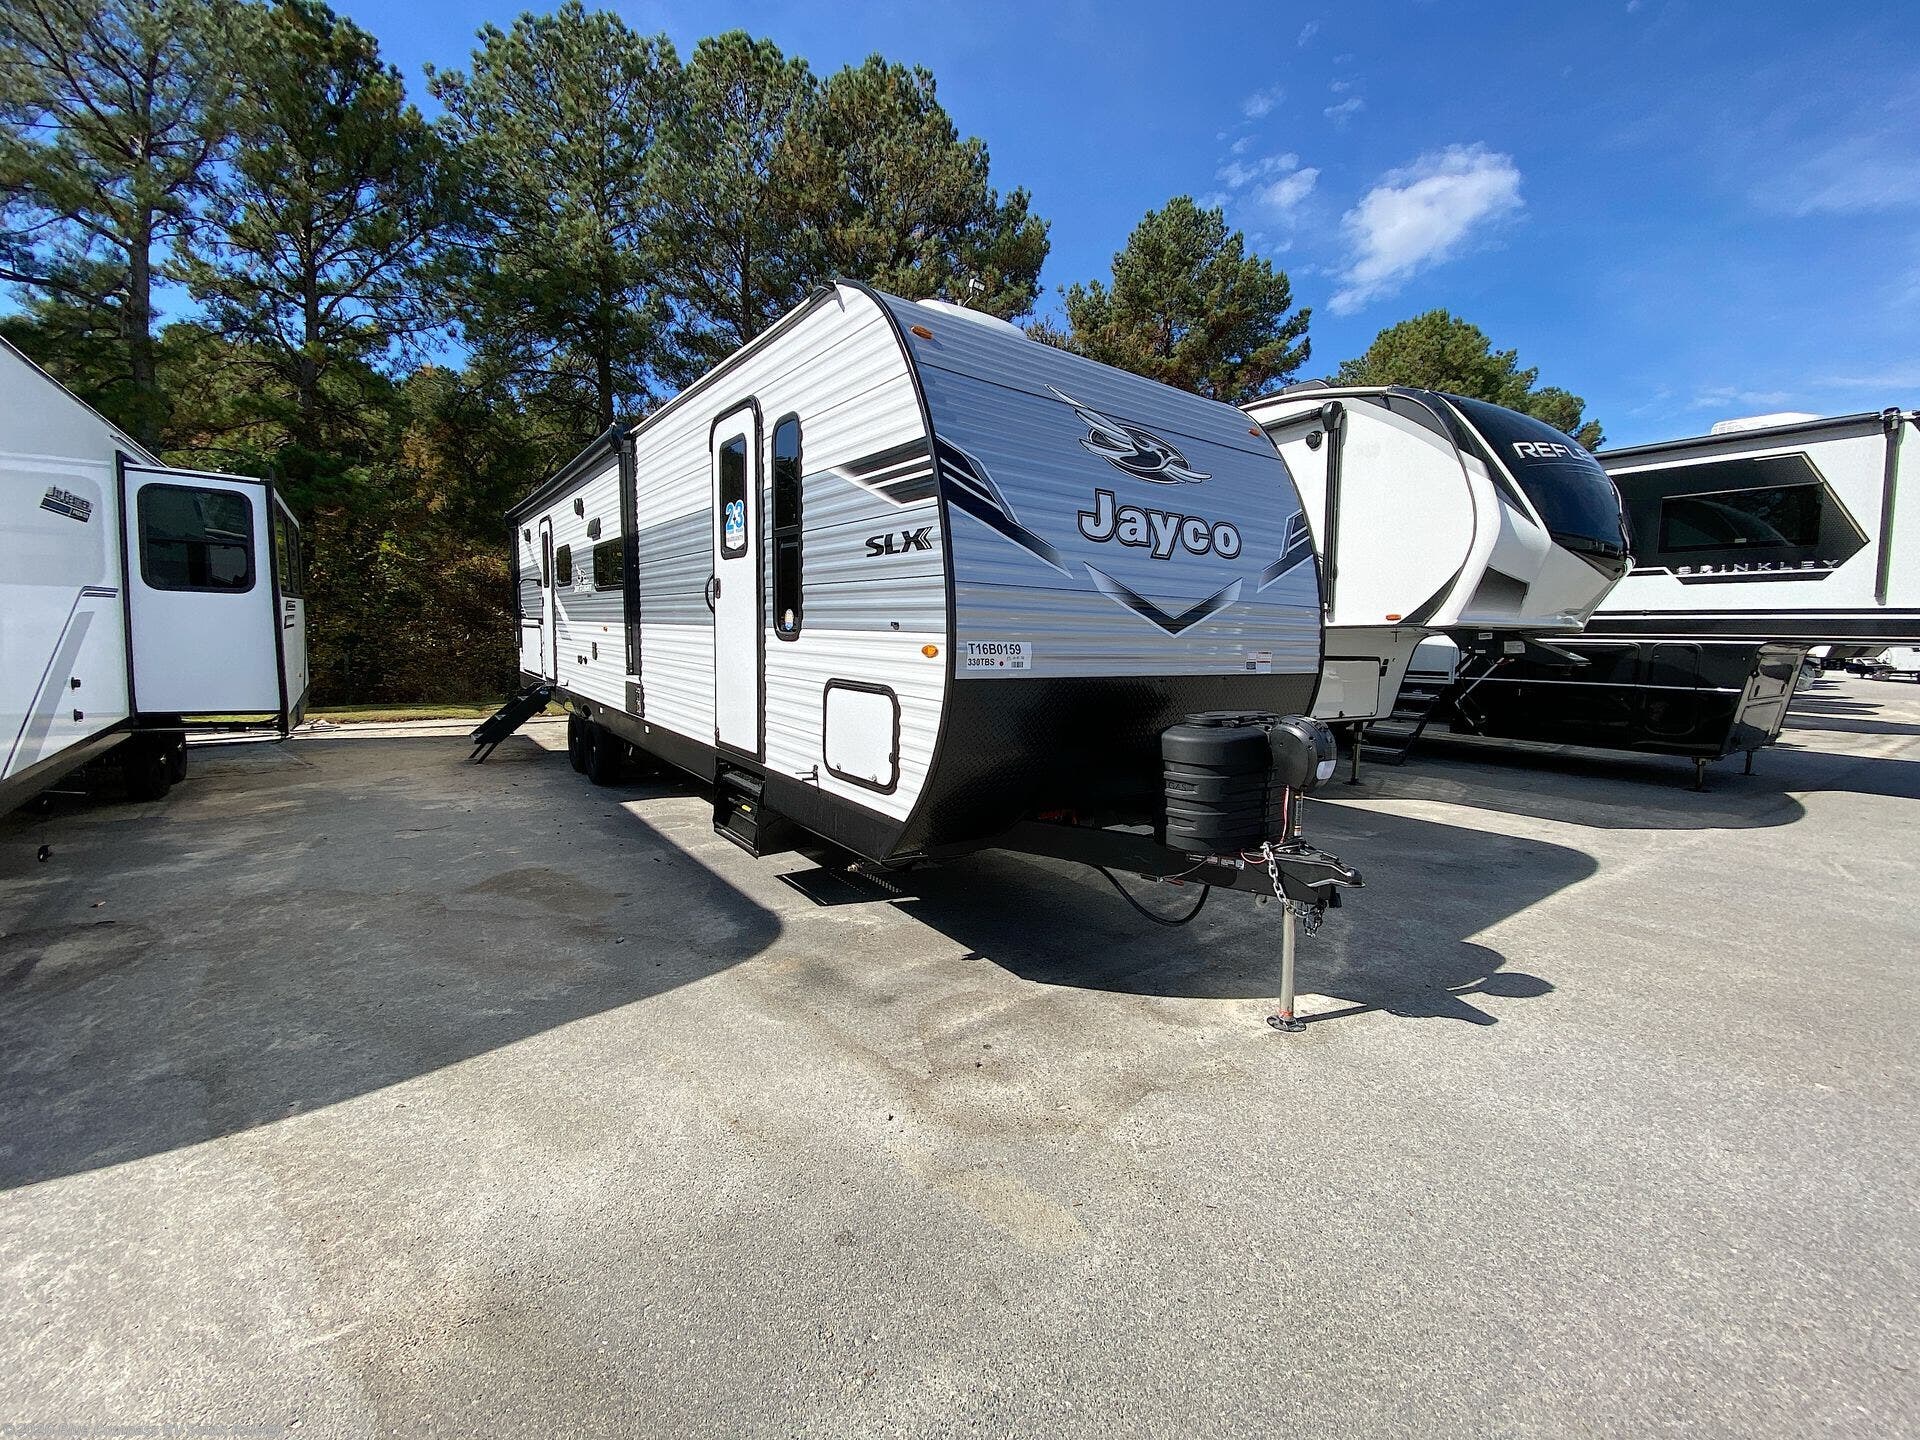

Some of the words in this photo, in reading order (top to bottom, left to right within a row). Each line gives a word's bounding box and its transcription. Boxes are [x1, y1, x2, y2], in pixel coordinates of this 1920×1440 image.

[1077, 488, 1242, 560] Jayco
[967, 643, 1022, 655] T16B0159
[967, 657, 995, 667] 330TBS
